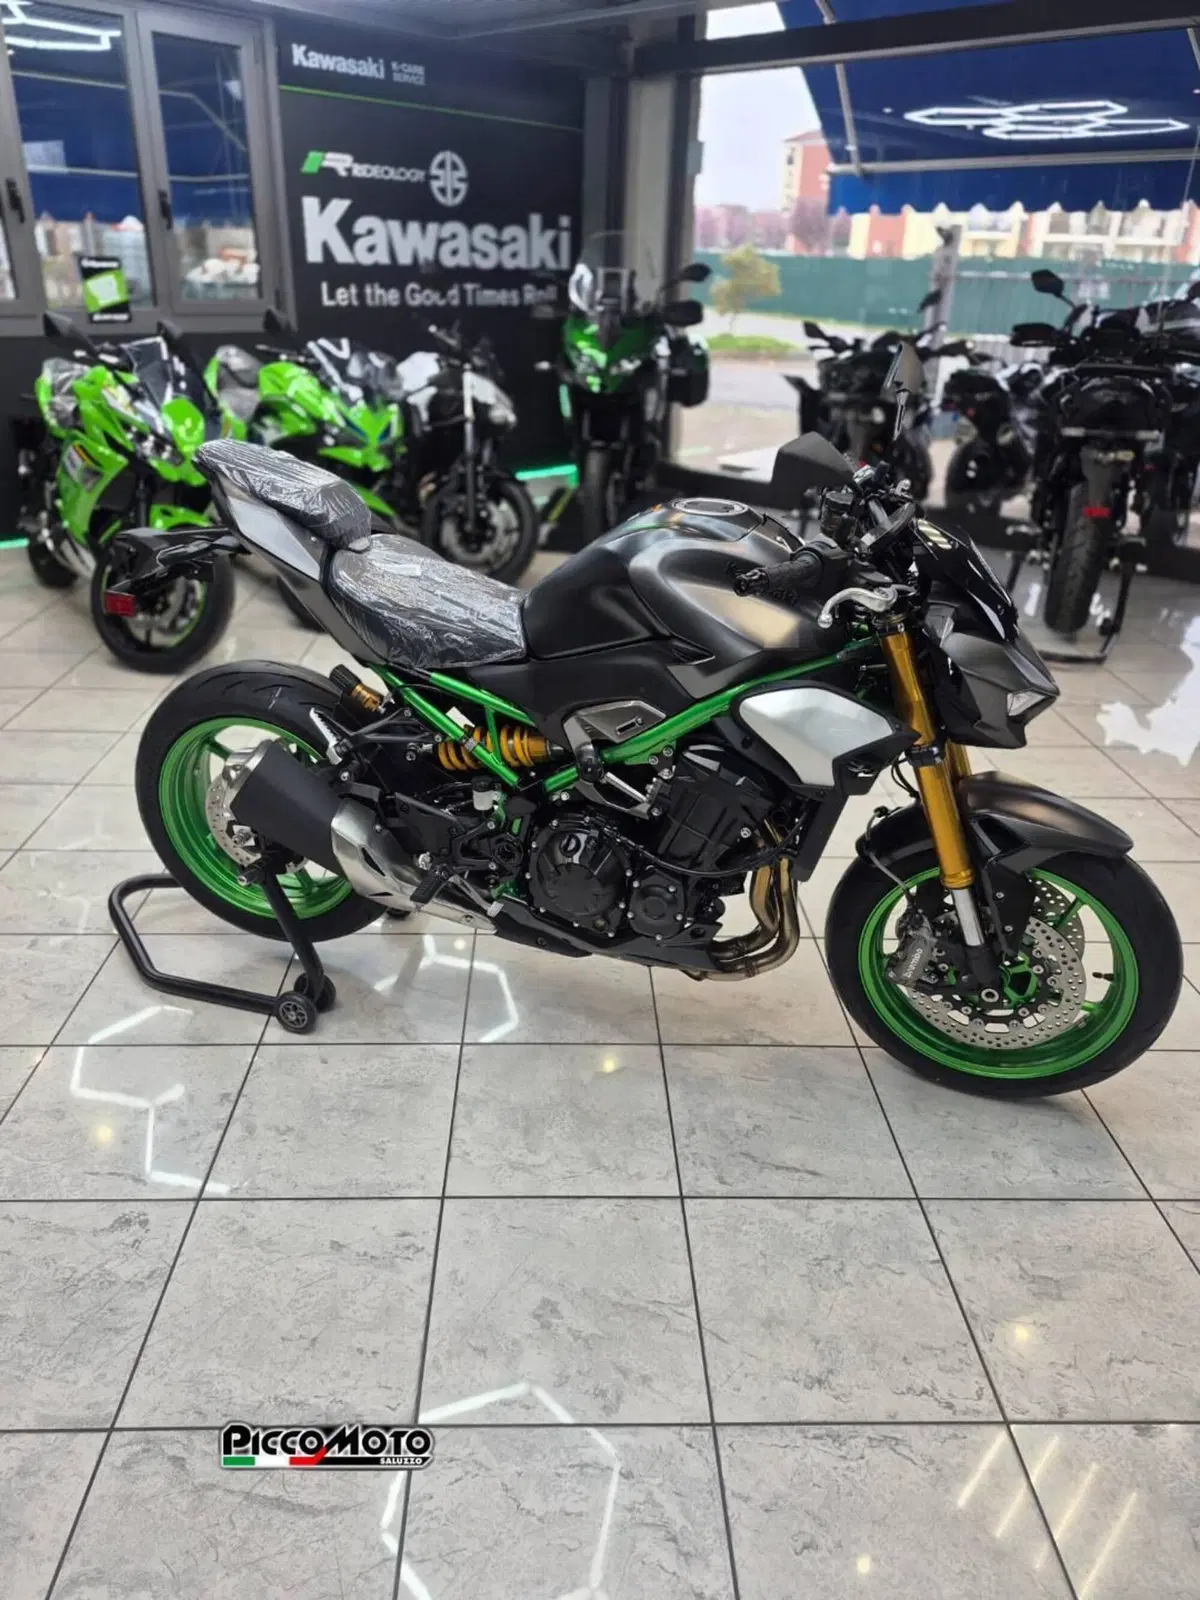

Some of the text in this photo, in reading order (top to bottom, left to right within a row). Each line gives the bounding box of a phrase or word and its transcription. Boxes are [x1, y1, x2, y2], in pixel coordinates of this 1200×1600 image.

[291, 43, 385, 79] Kawasaki
[301, 195, 572, 270] Kawasaki
[320, 281, 359, 307] Let
[364, 283, 400, 307] the
[404, 283, 460, 307] Good
[462, 283, 520, 306] Times
